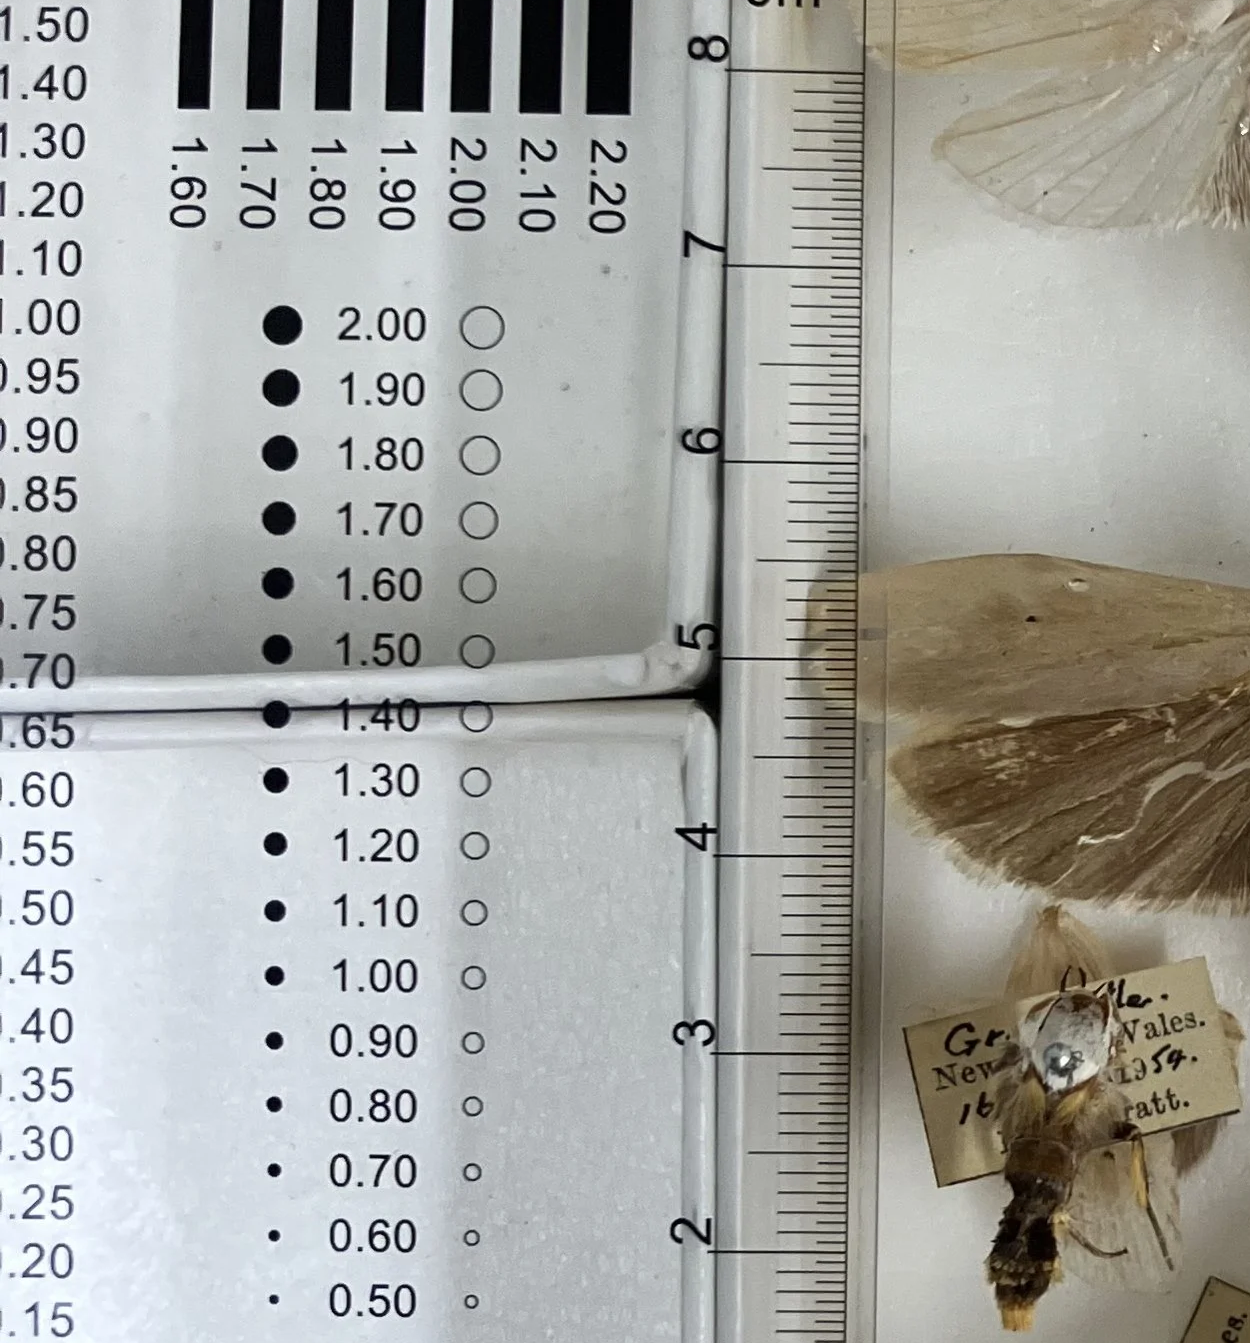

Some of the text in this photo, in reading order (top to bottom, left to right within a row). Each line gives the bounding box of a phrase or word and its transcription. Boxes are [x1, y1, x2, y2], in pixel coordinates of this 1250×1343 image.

[0, 6, 89, 43] 1.50
[688, 34, 730, 63] 8
[0, 64, 87, 101] 1.40
[169, 137, 208, 228] 1.60
[239, 138, 278, 229] 1.70
[309, 139, 348, 230] 1.80
[378, 140, 417, 231] 1.90
[448, 137, 487, 232] 2.00
[519, 138, 558, 233] 2.10
[588, 139, 628, 234] 2.20
[683, 230, 726, 258] 7
[0, 298, 80, 335] .00
[337, 307, 426, 342] 2.00
[340, 371, 425, 407] 1.90
[338, 436, 424, 471] 1.80
[681, 426, 723, 455] 6
[0, 475, 78, 512] .85
[337, 502, 423, 537] 1.70
[0, 534, 77, 571] .80
[336, 567, 422, 602] 1.60
[0, 594, 76, 631] .75
[336, 632, 421, 667] 1.50
[676, 622, 720, 652] 5
[0, 653, 75, 690] .70
[0, 712, 75, 749] .65
[335, 698, 421, 732] 1.40
[0, 771, 74, 808] .60
[335, 762, 420, 798] 1.30
[0, 831, 74, 868] .55
[334, 828, 419, 863] 1.20
[674, 821, 717, 852] 4
[0, 889, 74, 926] .50
[333, 893, 419, 928] 1.10
[0, 948, 74, 985] .45
[333, 958, 418, 993] 1.00
[0, 1007, 74, 1044] .40
[330, 1023, 418, 1058] 0.90
[672, 1018, 716, 1048] 3
[0, 1066, 74, 1103] .35
[329, 1088, 417, 1123] 0.80
[1122, 1087, 1191, 1122] ratt.
[0, 1125, 74, 1162] .30
[329, 1153, 417, 1188] 0.70
[0, 1184, 74, 1221] .25
[329, 1218, 417, 1253] 0.60
[669, 1216, 713, 1246] 2
[0, 1242, 74, 1279] .20
[329, 1283, 416, 1318] 0.50
[0, 1301, 74, 1338] .15
